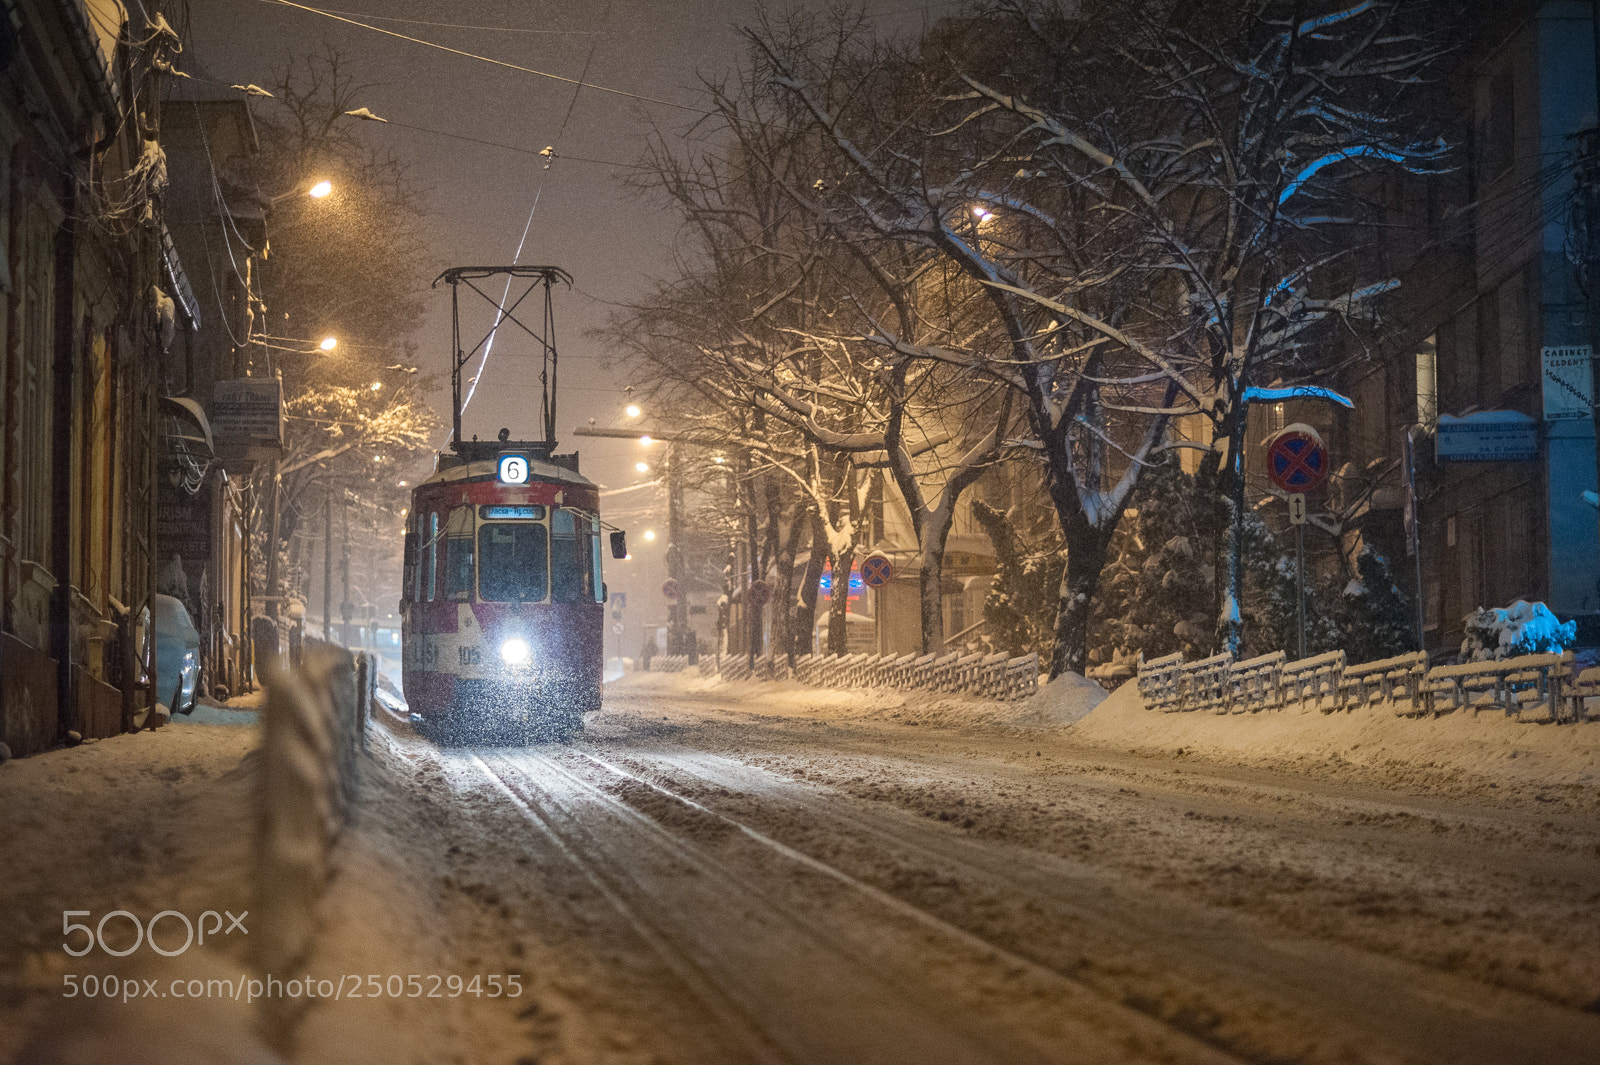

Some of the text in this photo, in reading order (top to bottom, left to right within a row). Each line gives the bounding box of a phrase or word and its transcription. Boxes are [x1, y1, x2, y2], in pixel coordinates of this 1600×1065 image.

[1545, 348, 1588, 357] CABINET
[507, 461, 519, 480] 6
[458, 645, 481, 666] 105
